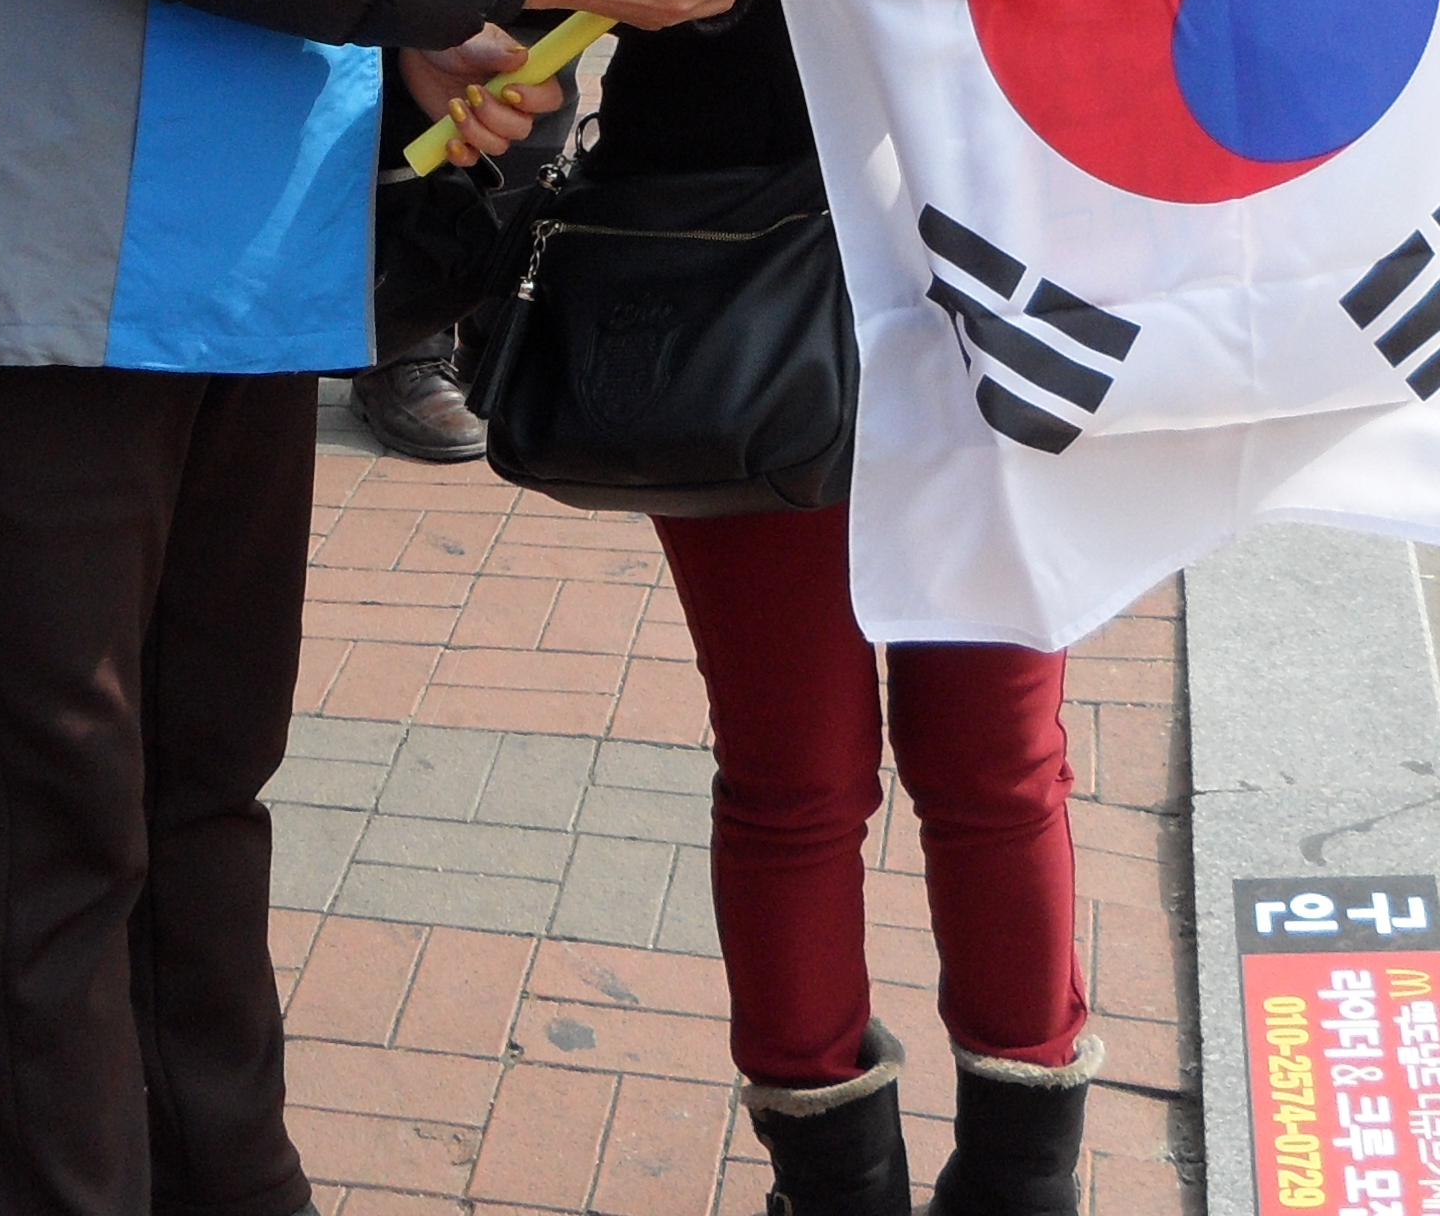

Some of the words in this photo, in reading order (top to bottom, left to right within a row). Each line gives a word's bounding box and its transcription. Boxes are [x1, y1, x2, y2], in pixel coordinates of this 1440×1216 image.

[1254, 891, 1428, 934] 구인
[1318, 970, 1384, 1058] 라이더
[1263, 996, 1325, 1208] 010-2574-0729
[1331, 1064, 1384, 1086] &
[1333, 1092, 1395, 1160] 크루
